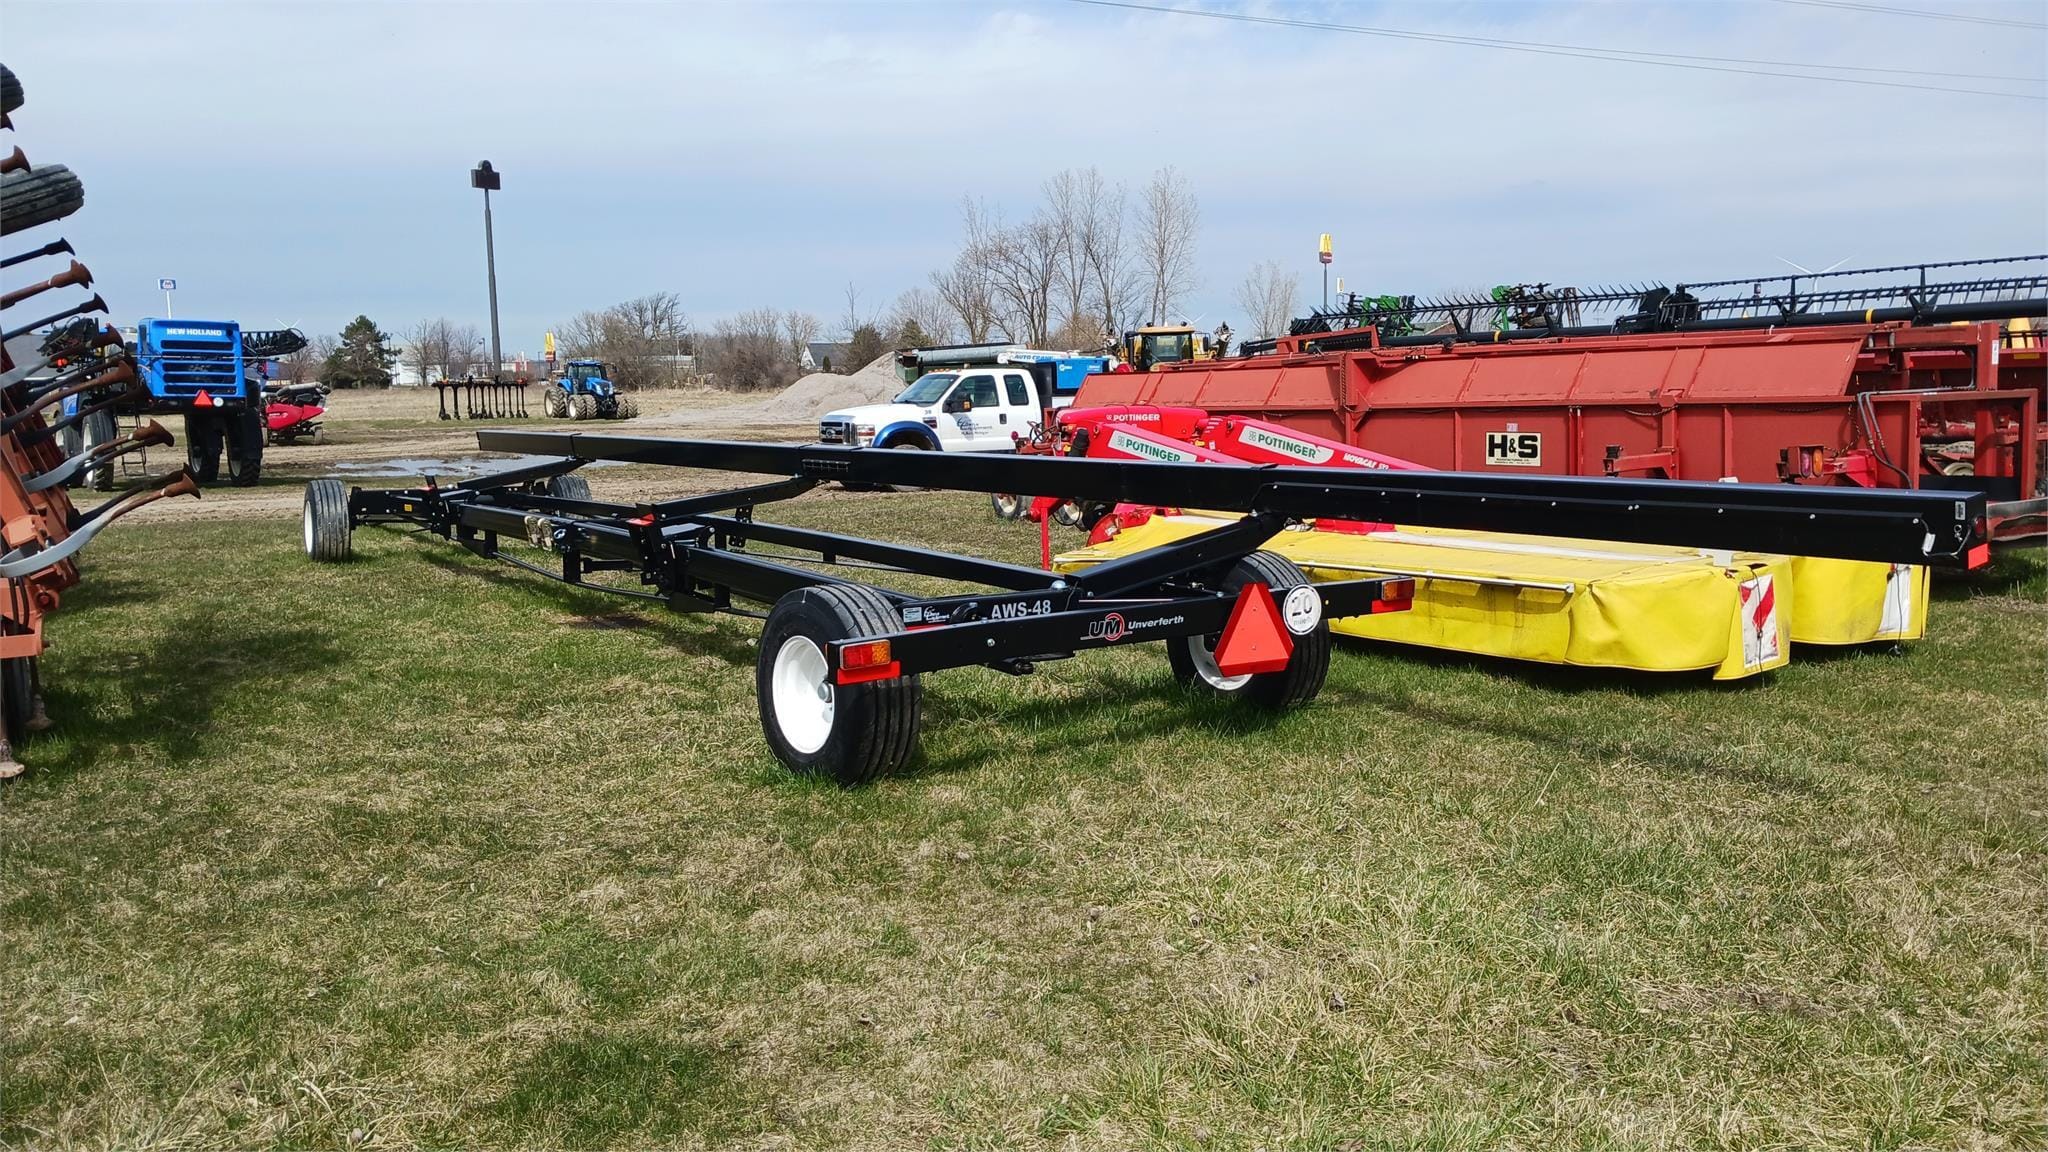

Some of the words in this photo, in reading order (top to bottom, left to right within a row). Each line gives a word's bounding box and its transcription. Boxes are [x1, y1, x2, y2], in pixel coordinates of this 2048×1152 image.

[167, 328, 186, 336] NEW
[187, 328, 222, 336] HOLLAND
[1488, 434, 1538, 458] H&S
[991, 600, 1051, 619] AWS-48
[1128, 615, 1184, 630] Unverferth
